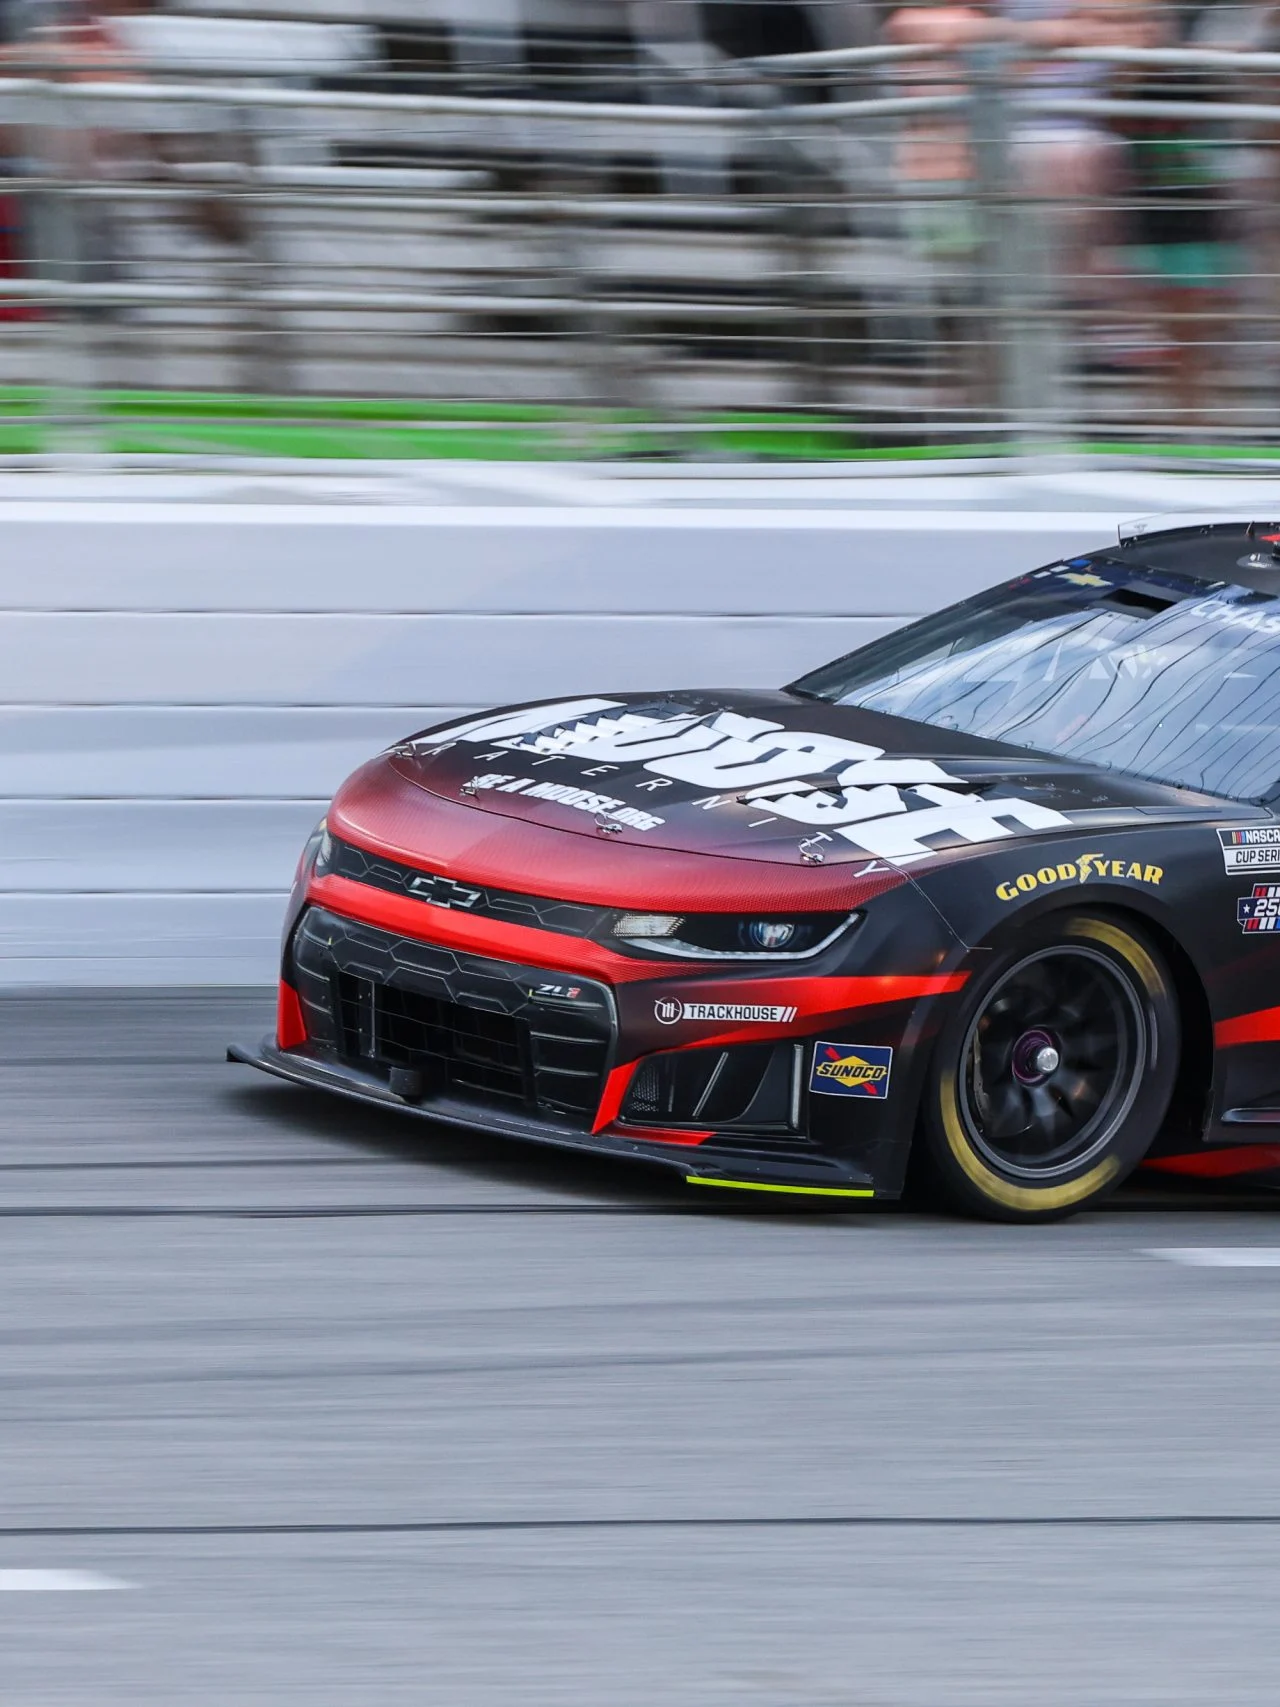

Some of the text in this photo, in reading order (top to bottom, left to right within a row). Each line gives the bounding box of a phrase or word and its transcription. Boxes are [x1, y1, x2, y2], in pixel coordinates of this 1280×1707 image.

[463, 773, 666, 831] BE A MOOSE.ORG
[1235, 850, 1256, 864] CUP
[995, 853, 1164, 901] GOODYEAR
[688, 1004, 778, 1021] TRACKHOUSE
[819, 1063, 885, 1079] SUNOCO
